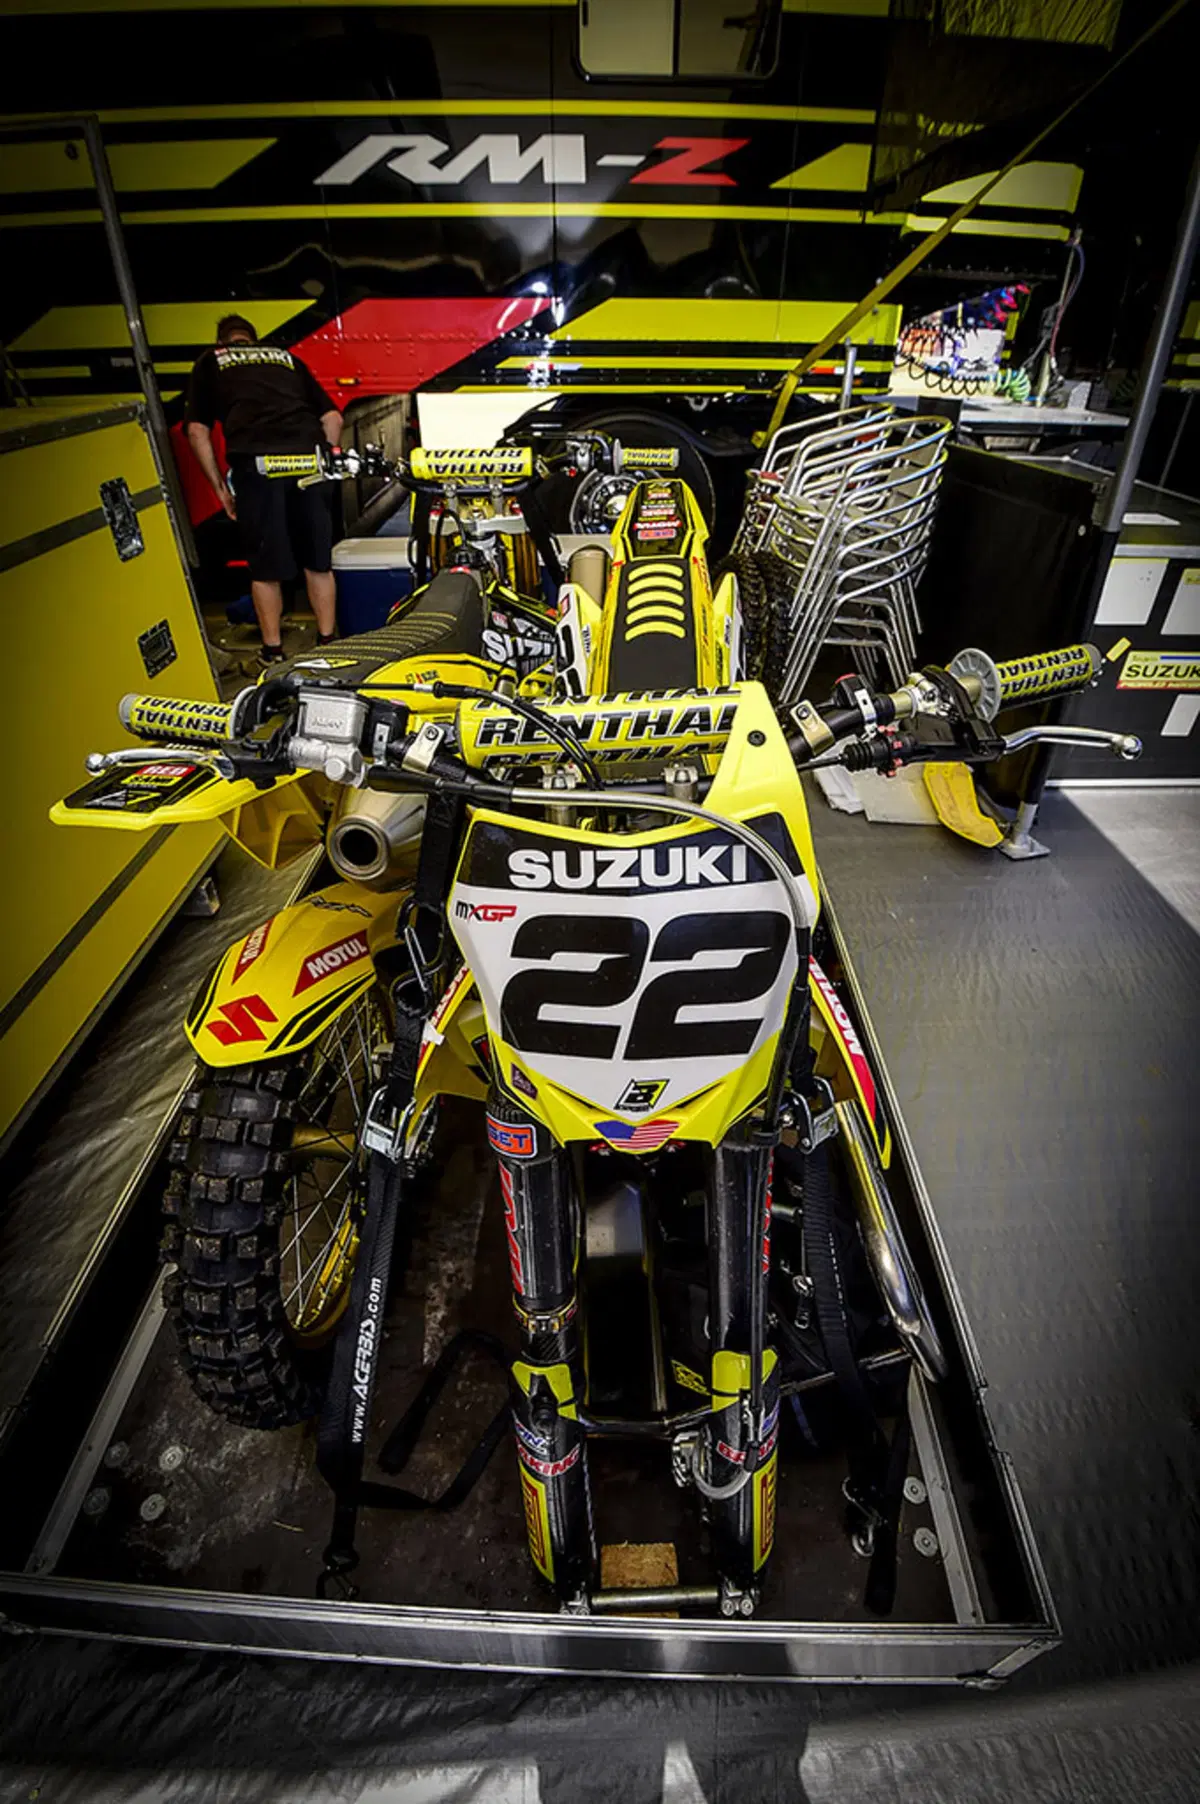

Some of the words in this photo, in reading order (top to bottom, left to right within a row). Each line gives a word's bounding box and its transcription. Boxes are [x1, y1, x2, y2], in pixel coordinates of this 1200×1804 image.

[313, 134, 750, 185] RM-Z
[998, 648, 1084, 678] RENTHAL
[1001, 662, 1090, 695] RENTHAL
[134, 708, 227, 734] RENTHAL
[508, 845, 747, 889] SUZUKI
[455, 900, 518, 922] MXGP
[306, 938, 368, 979] MOTUL
[501, 911, 791, 1060] 22
[351, 1277, 382, 1443] www.ACERBIS.com
